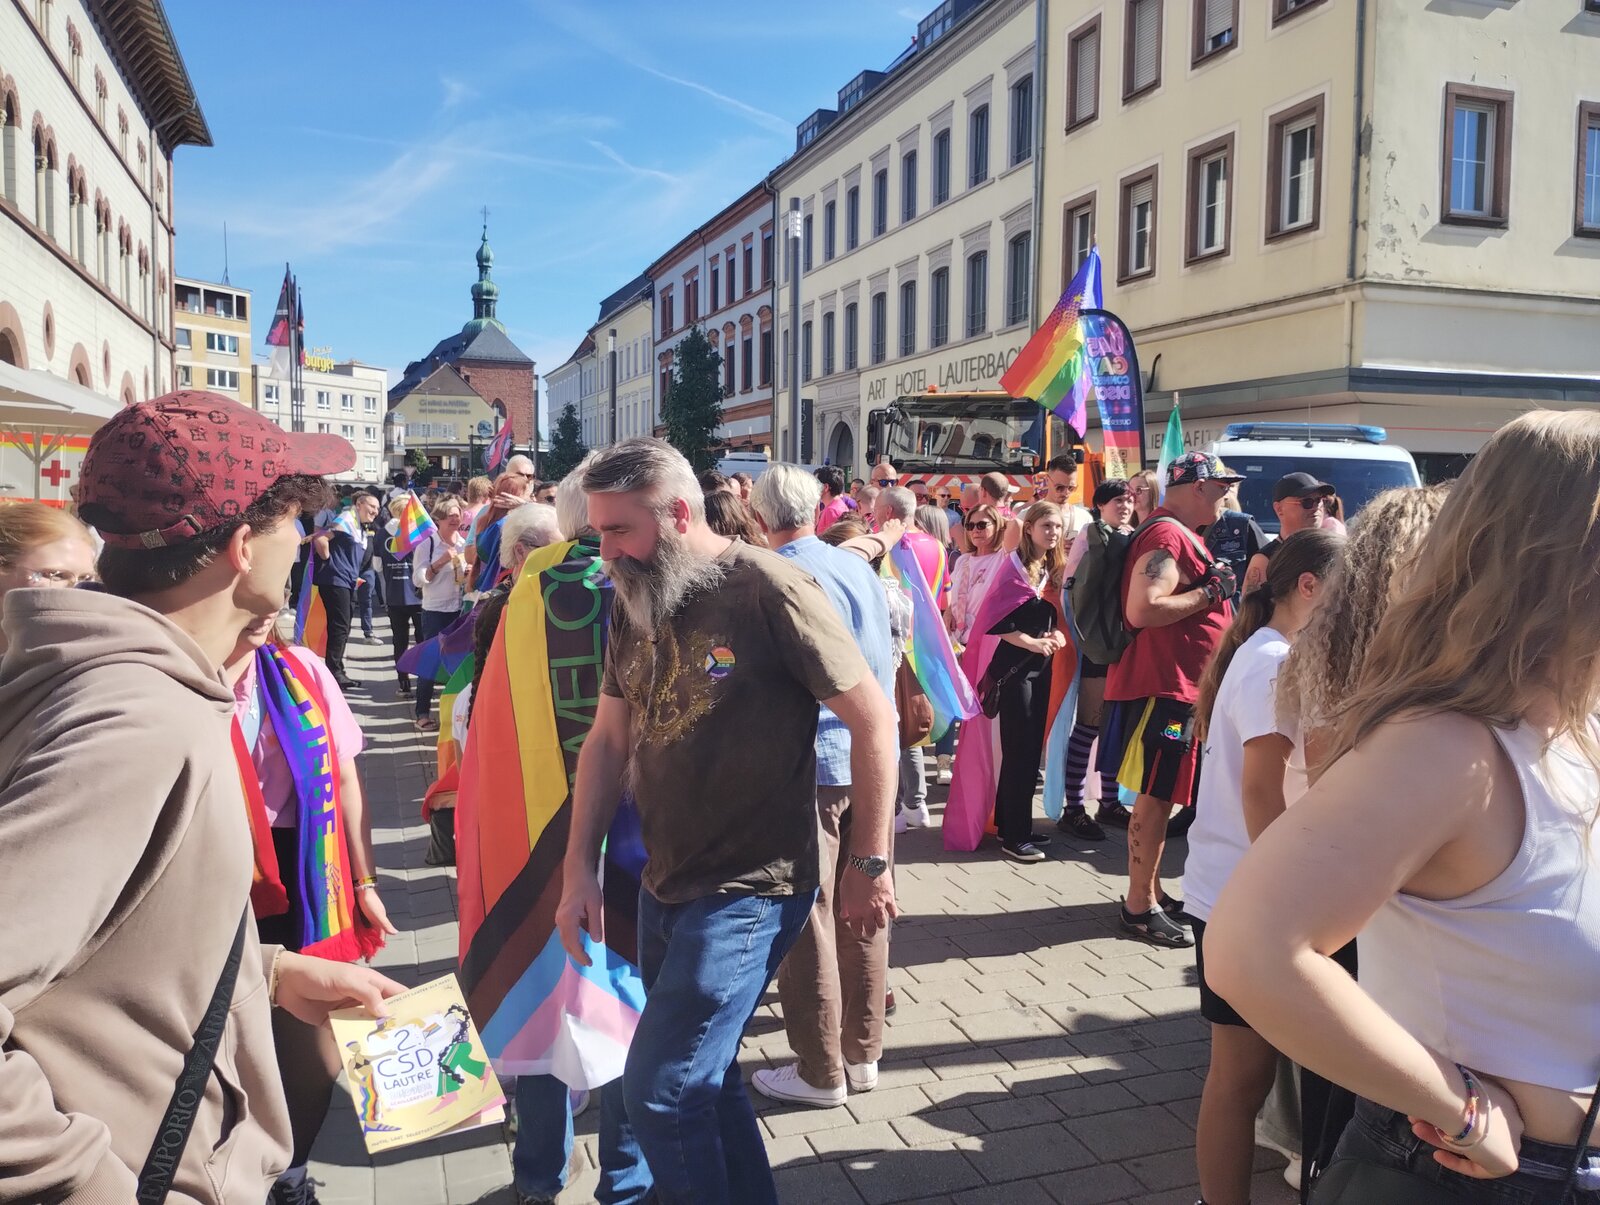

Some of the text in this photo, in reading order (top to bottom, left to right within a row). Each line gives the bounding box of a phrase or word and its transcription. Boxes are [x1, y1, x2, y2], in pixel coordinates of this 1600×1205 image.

[867, 346, 1022, 401] ART HOTEL LAUTERBAC
[288, 700, 336, 843] LIEBE
[394, 1029, 422, 1051] 2.
[377, 1048, 433, 1077] CSD
[383, 1069, 434, 1090] LAUTRE
[141, 1089, 198, 1203] EMPORIO
